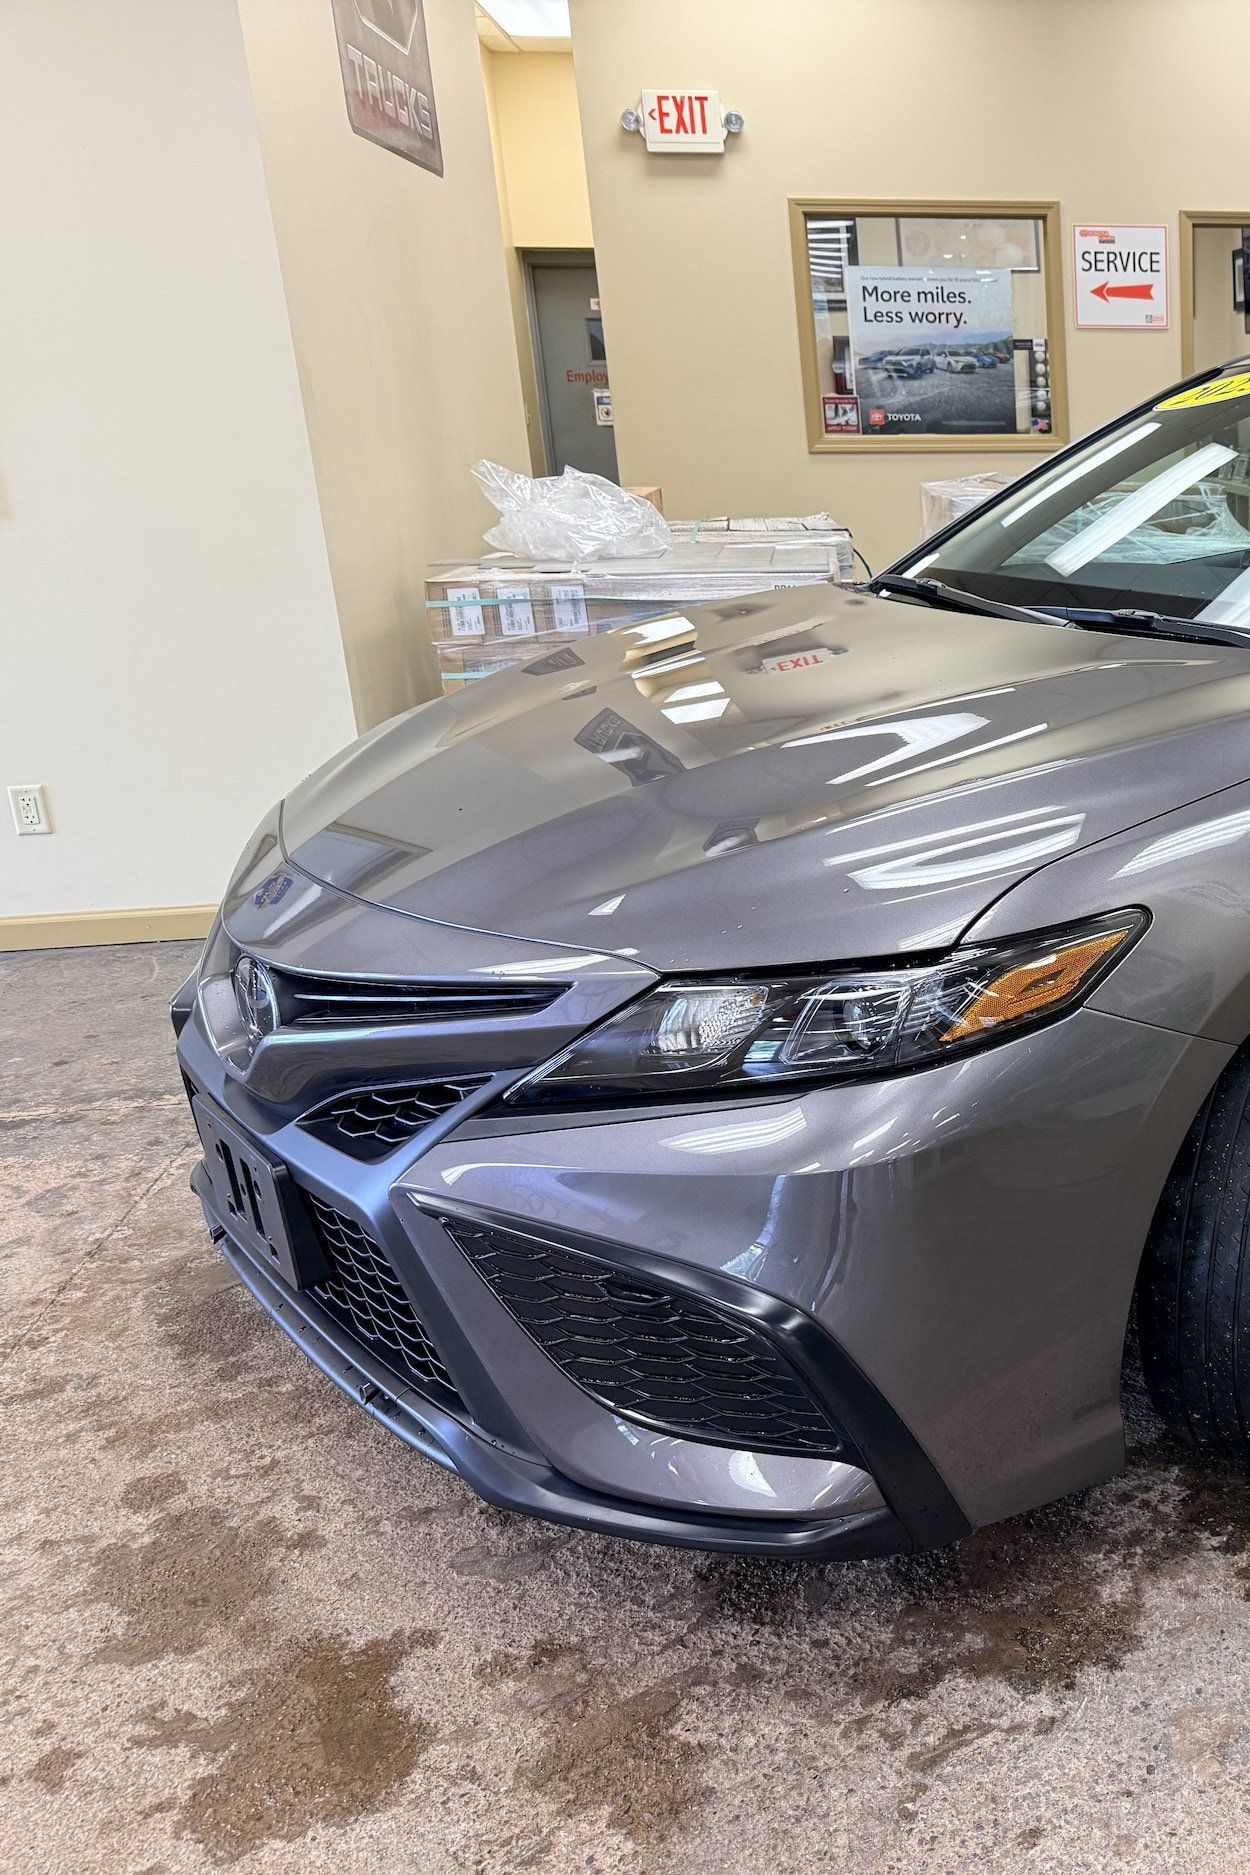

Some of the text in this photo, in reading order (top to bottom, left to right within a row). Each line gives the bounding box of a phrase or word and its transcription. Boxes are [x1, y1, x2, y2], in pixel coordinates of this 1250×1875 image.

[347, 44, 433, 140] TRUCKS
[657, 96, 708, 134] EXIT
[1081, 251, 1160, 273] SERVICE
[862, 285, 971, 304] More miles.
[863, 306, 967, 329] Less worry.
[887, 413, 921, 421] TOYOTA
